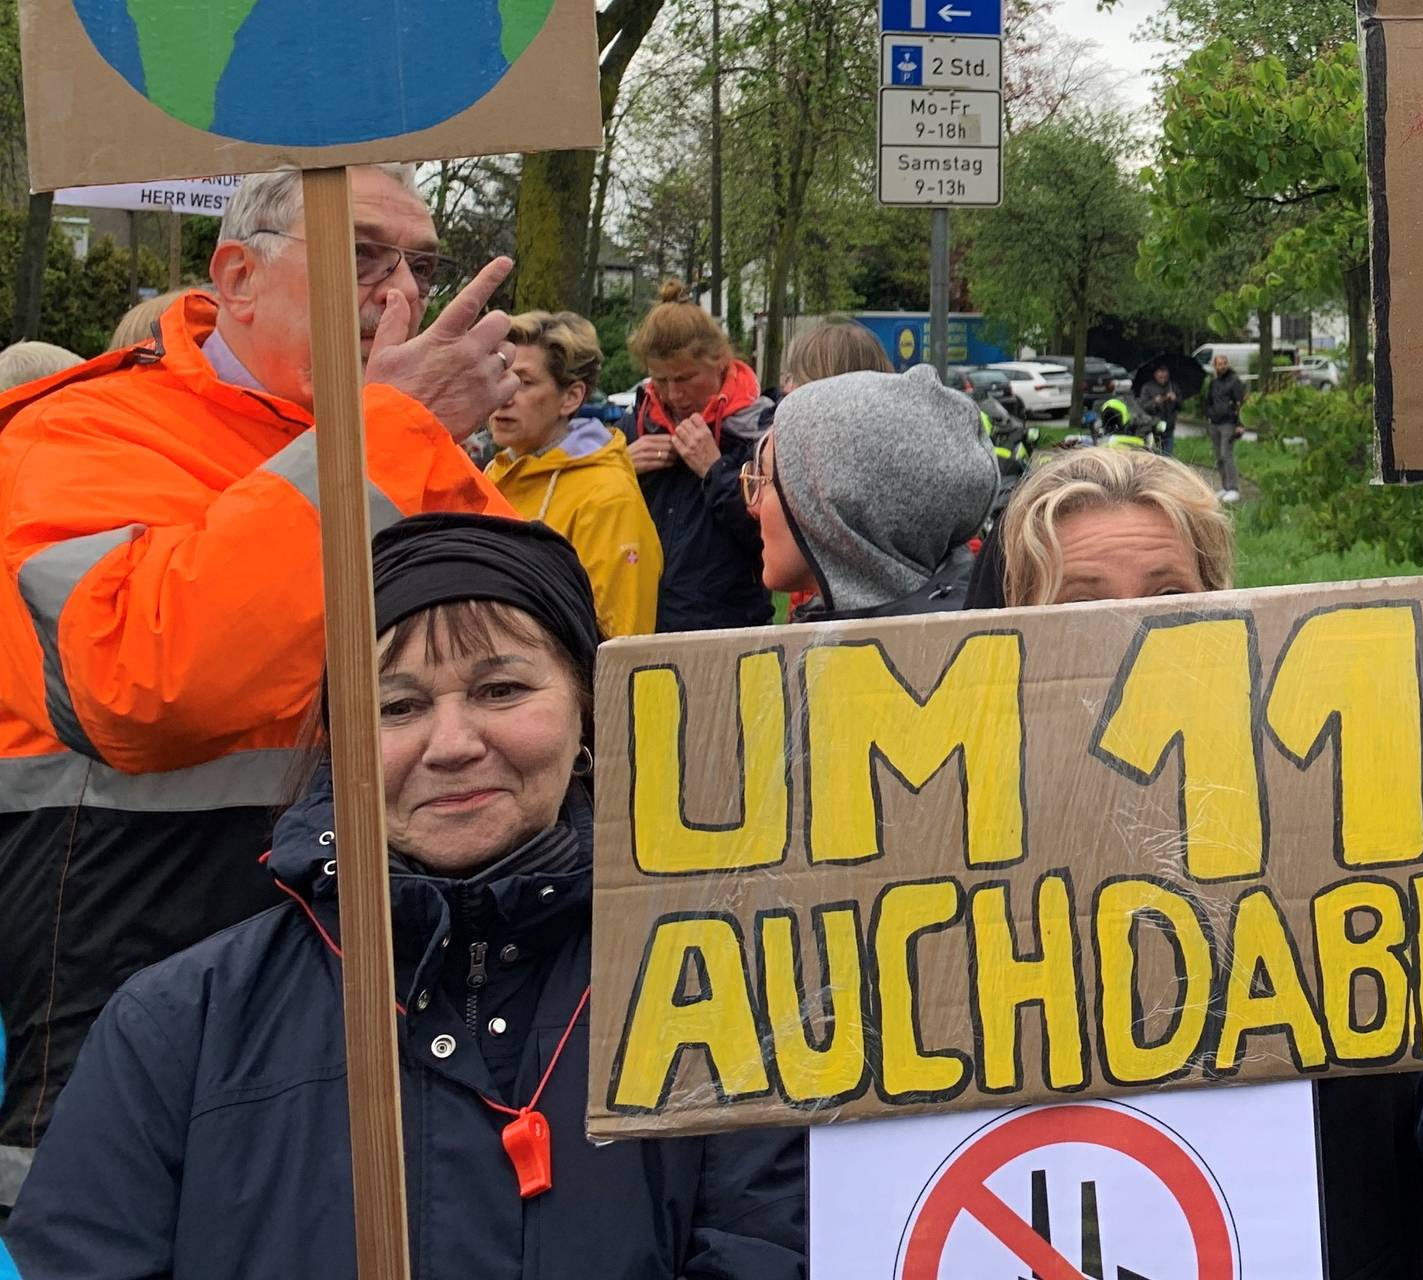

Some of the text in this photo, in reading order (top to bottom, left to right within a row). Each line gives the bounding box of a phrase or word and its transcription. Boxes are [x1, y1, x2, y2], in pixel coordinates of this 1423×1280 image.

[932, 57, 990, 77] 2 Std.
[910, 98, 971, 116] Mo-Fr
[915, 121, 966, 139] 9-18h
[897, 154, 983, 176] Samstag
[201, 175, 246, 187] NDE
[915, 179, 966, 196] 9-13h
[140, 188, 186, 206] HERR
[628, 628, 1028, 876] UM
